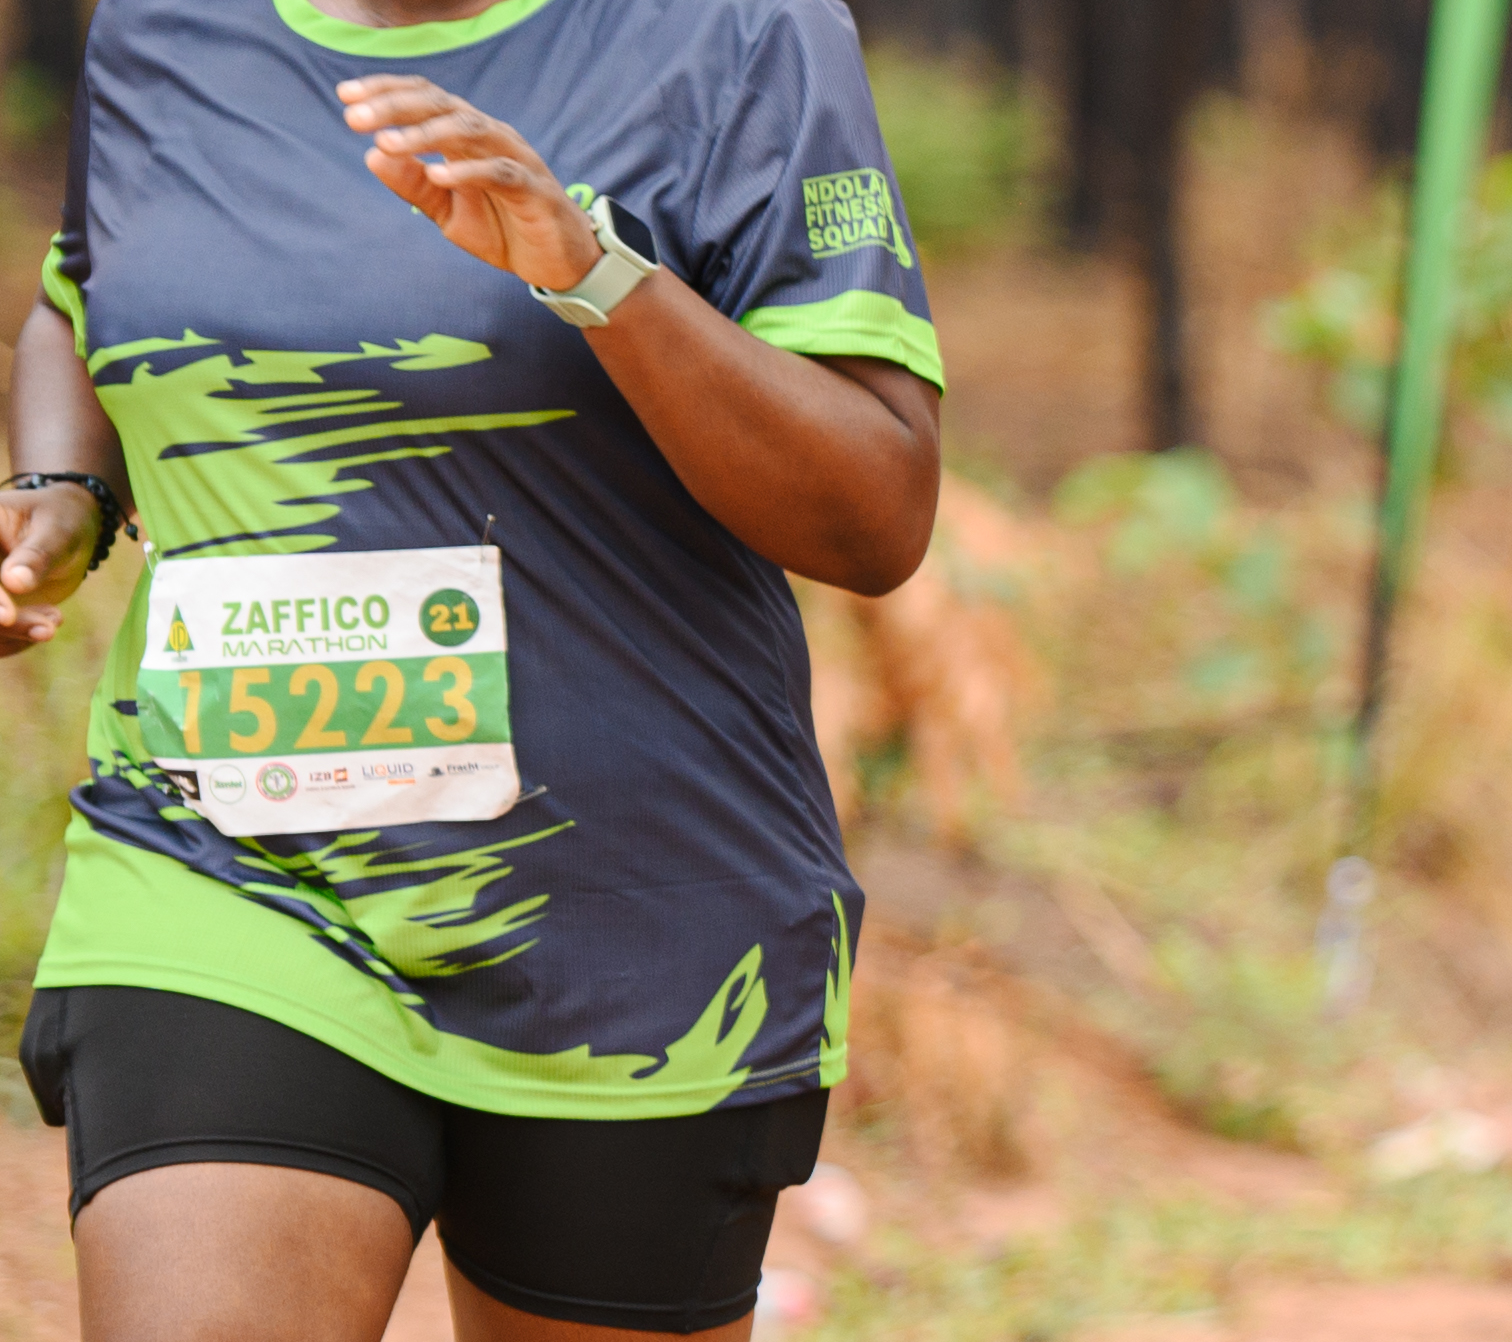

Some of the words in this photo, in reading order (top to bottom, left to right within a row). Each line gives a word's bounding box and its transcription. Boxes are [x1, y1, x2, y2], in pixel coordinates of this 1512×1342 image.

[803, 173, 881, 205] NDOLA
[808, 216, 888, 251] SQUAD
[220, 594, 391, 636] ZAFFICO
[428, 602, 475, 633] 21
[222, 634, 388, 658] MARATHON
[178, 655, 478, 755] 15223
[361, 762, 414, 777] LIQUID
